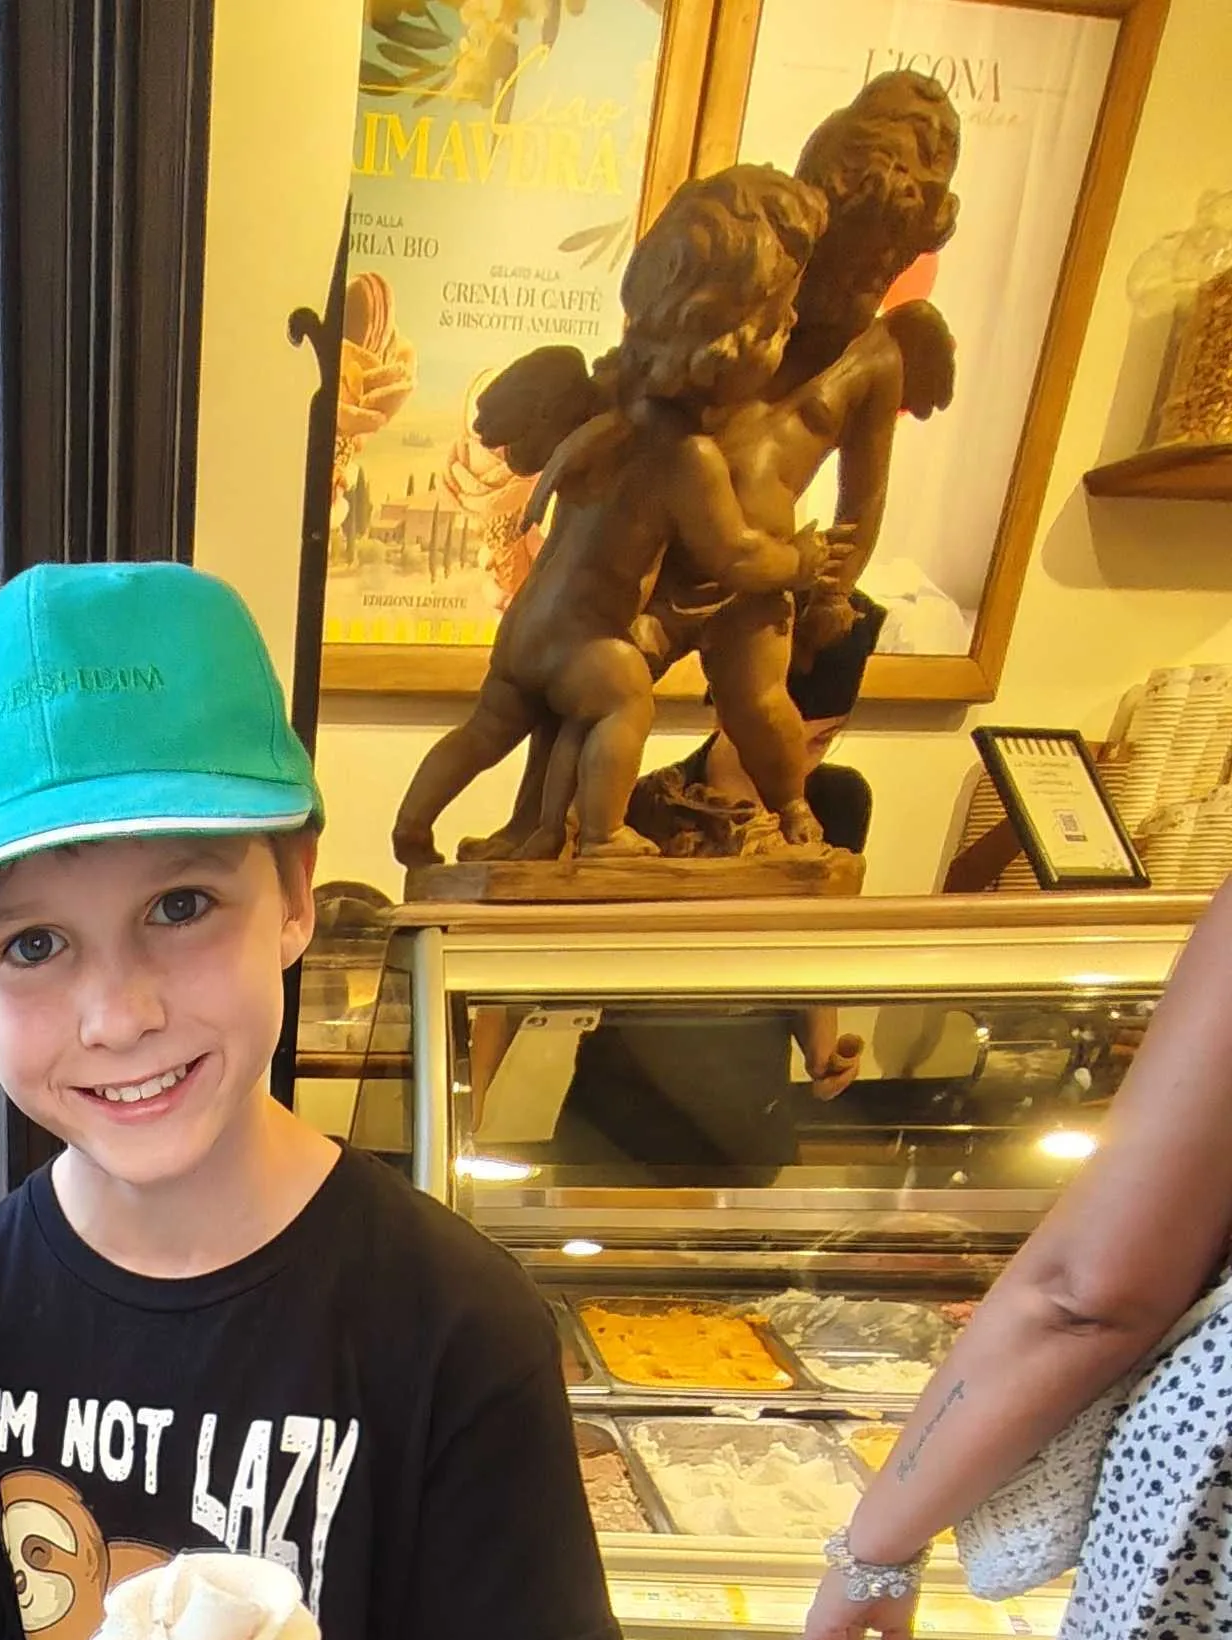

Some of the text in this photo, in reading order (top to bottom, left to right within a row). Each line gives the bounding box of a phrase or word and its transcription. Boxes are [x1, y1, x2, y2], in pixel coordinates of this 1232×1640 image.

[351, 111, 624, 195] IMAVERA
[375, 213, 404, 229] ALLA
[403, 235, 439, 259] BIO
[489, 264, 560, 282] GELATO ALLA
[442, 281, 603, 313] CREMA DI CAFFÈ
[439, 309, 600, 337] & BISCOTTI AMARETTI
[362, 594, 413, 608] EDIZIONI
[60, 1396, 175, 1496] NOT
[191, 1412, 360, 1622] LAZY
